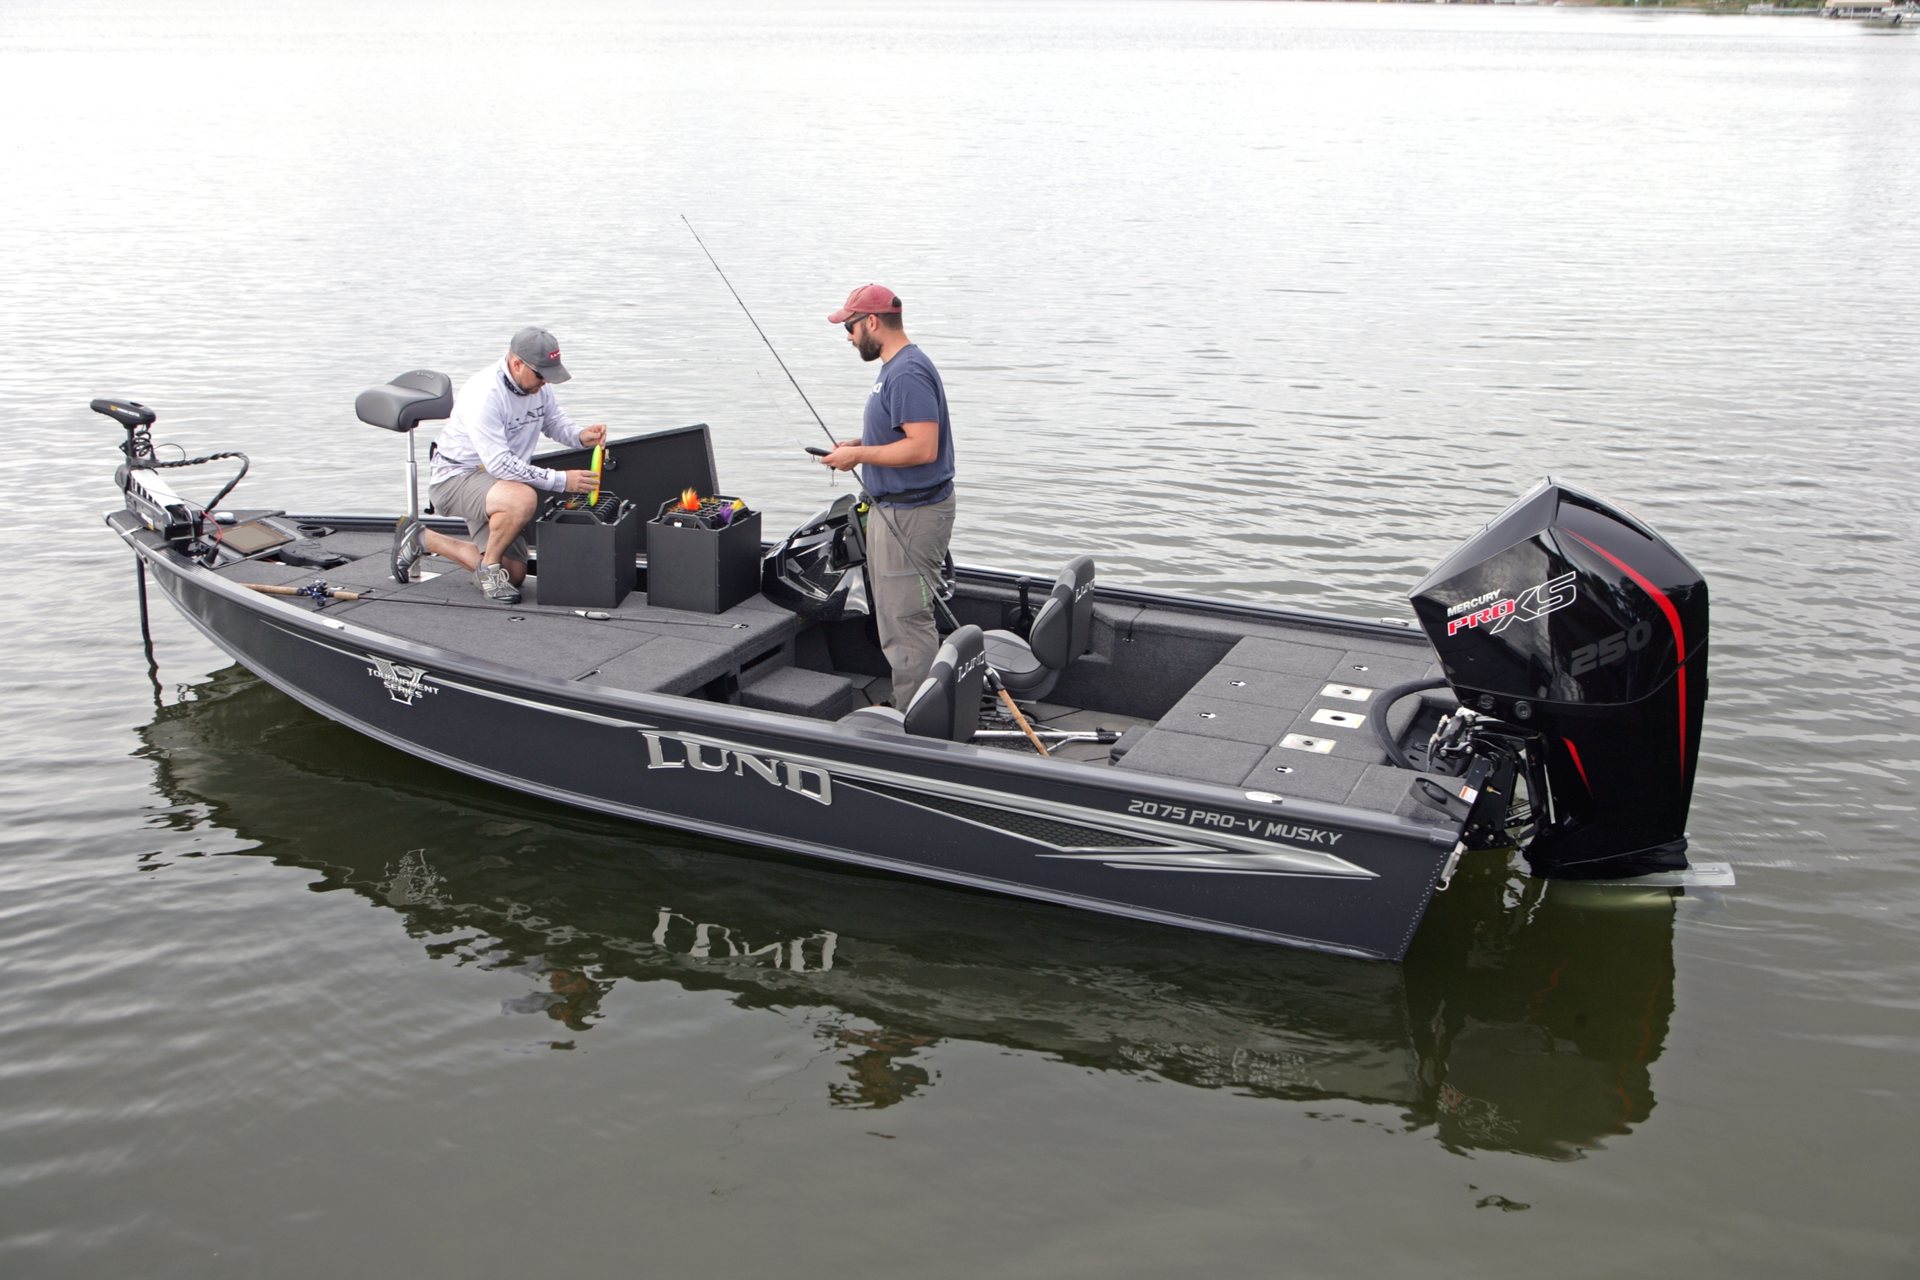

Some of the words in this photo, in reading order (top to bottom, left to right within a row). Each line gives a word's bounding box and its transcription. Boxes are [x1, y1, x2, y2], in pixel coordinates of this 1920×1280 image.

[1447, 589, 1502, 617] MERCURY
[1571, 620, 1652, 677] 250
[367, 667, 440, 695] TOURNAMENT
[383, 680, 424, 699] SERIES
[641, 731, 833, 806] LUND
[1127, 799, 1186, 820] 2075
[1188, 809, 1263, 833] PRO-V
[1264, 821, 1343, 846] MUSKY
